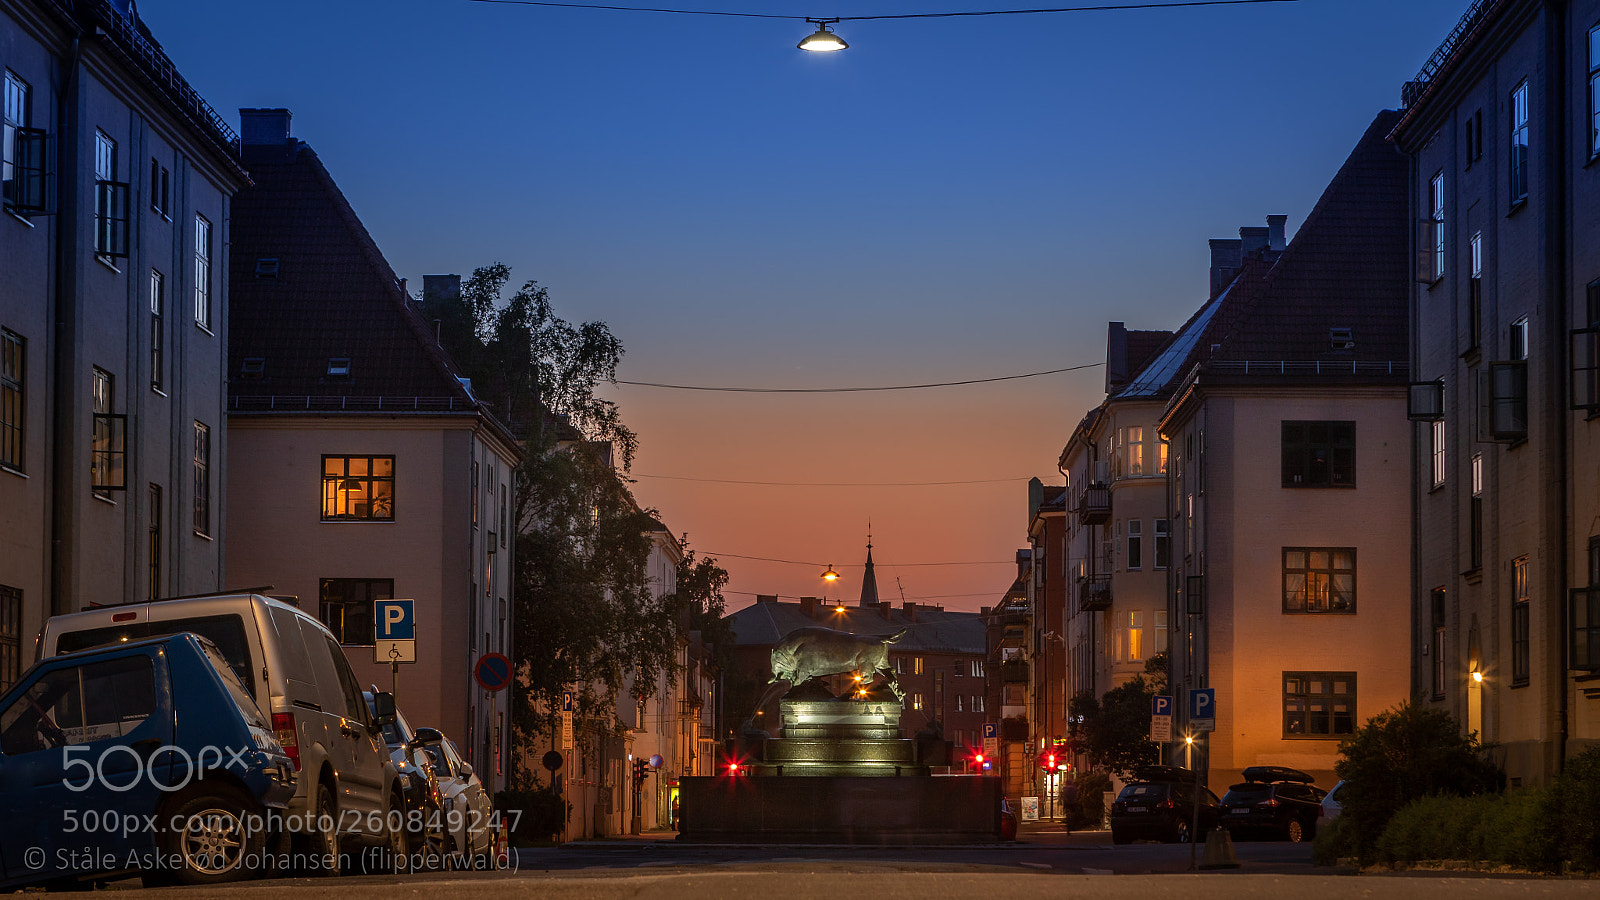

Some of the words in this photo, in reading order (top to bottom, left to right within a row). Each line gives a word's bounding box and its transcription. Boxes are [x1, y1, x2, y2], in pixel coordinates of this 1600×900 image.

[384, 605, 405, 635] P
[564, 694, 571, 710] P
[1156, 698, 1168, 714] P
[1196, 693, 1209, 716] P
[985, 726, 993, 736] P
